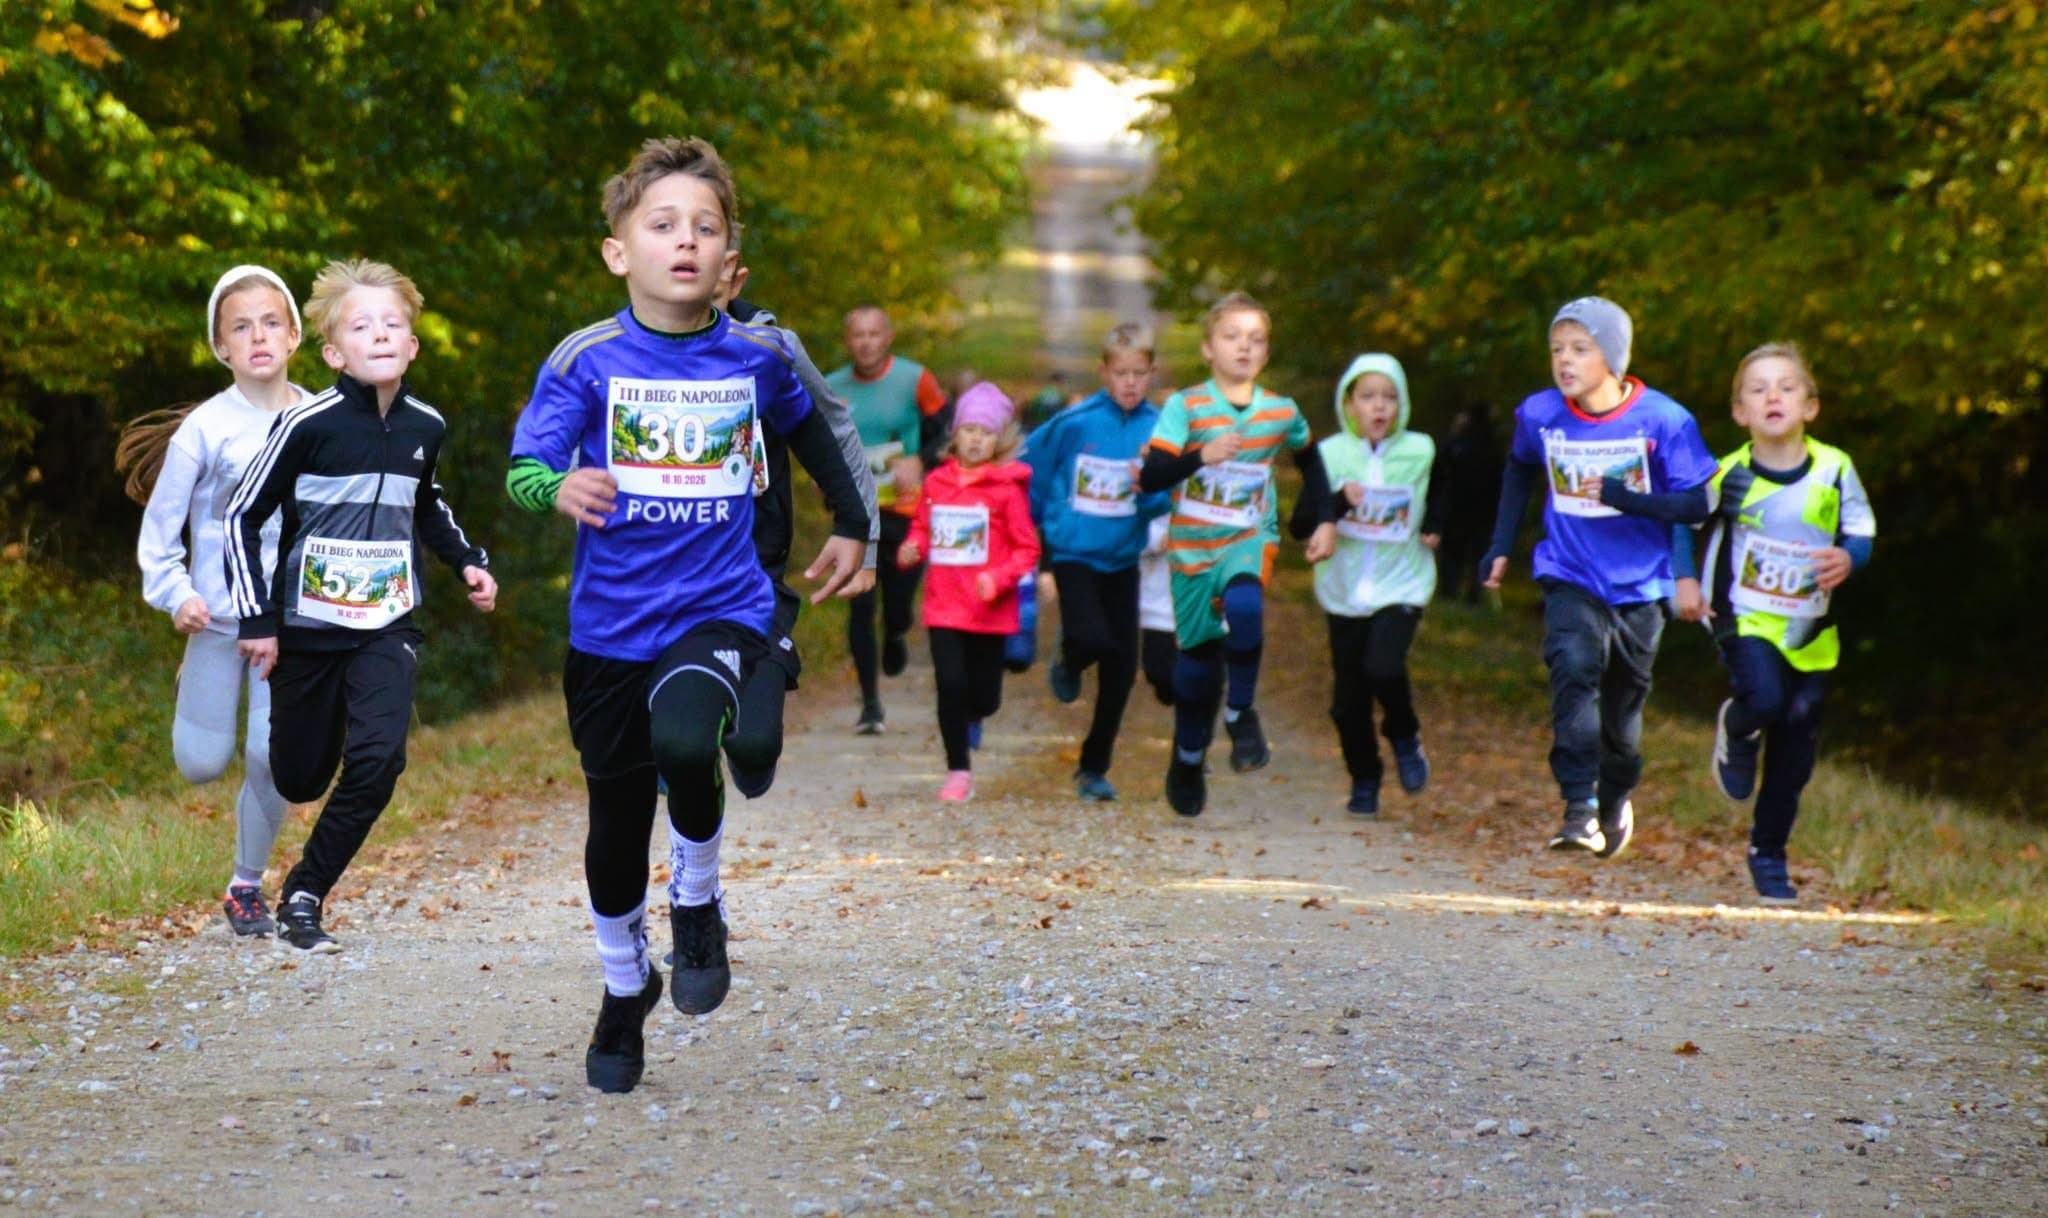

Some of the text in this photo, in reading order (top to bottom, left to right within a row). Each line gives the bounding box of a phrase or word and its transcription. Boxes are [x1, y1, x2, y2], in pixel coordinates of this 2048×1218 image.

[620, 387, 751, 404] III BIEG NAPOLEONA
[637, 413, 706, 463] 30
[1087, 474, 1119, 500] 44
[1201, 477, 1233, 507] 11
[626, 499, 730, 523] POWER
[310, 543, 405, 559] III BIEG NAPOLEONA
[321, 561, 371, 602] 52
[1757, 560, 1802, 595] 80
